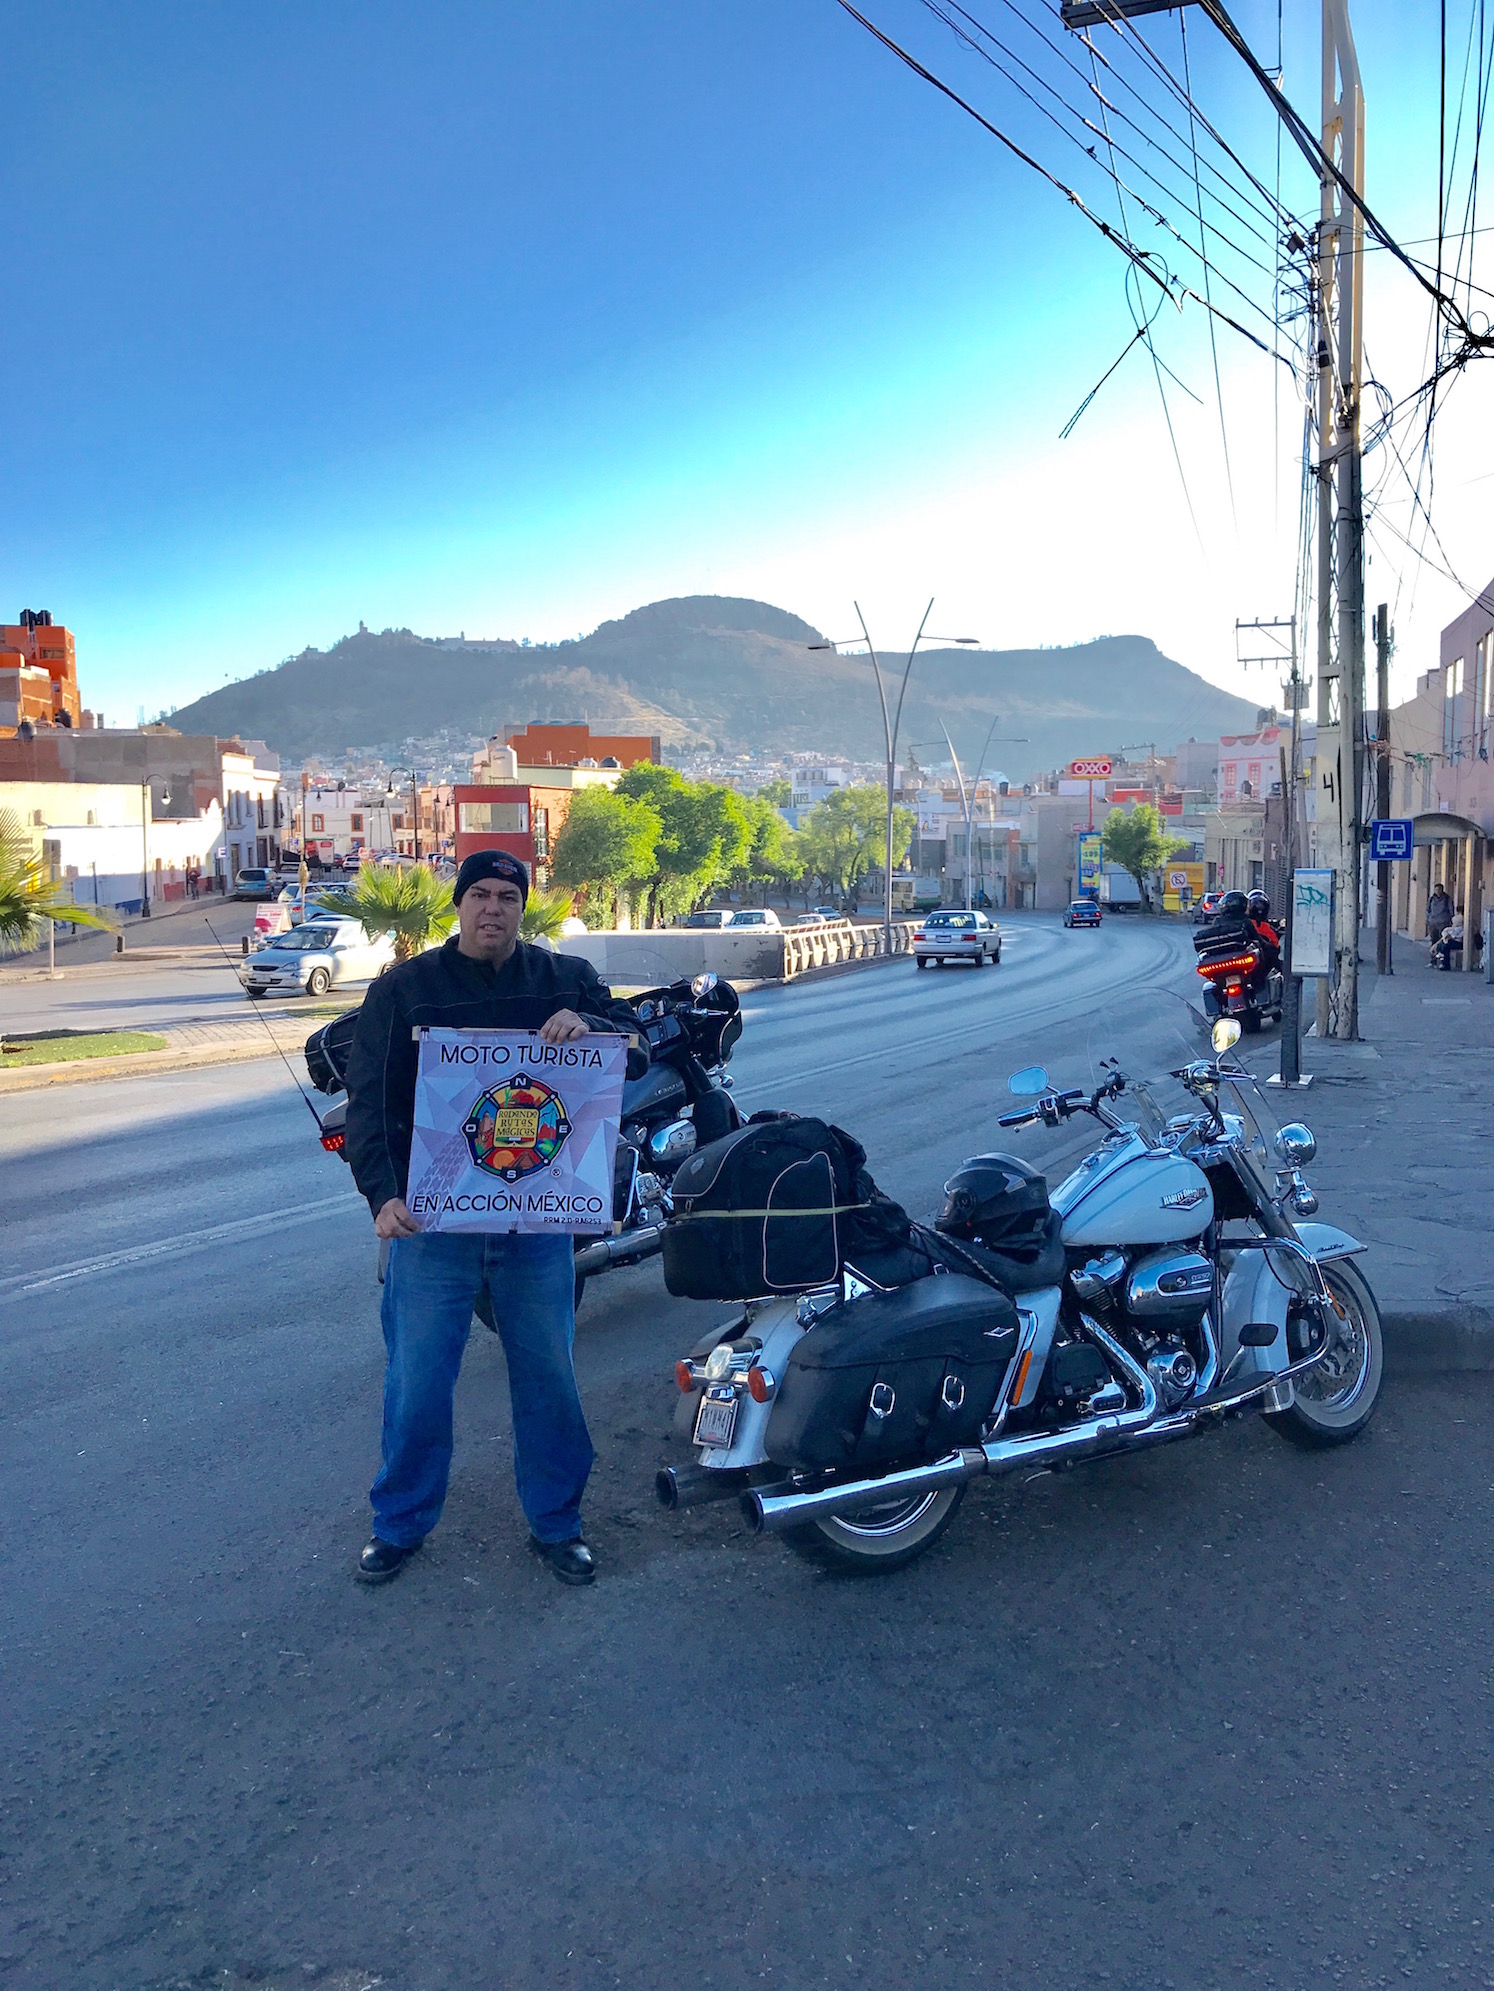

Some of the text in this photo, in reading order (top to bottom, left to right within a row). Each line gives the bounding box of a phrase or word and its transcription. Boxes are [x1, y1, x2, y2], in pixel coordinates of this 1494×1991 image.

[1074, 762, 1110, 774] OXXO
[1323, 771, 1334, 803] 4
[217, 847, 227, 858] E
[441, 1044, 603, 1068] MOTO TURISTA
[514, 1077, 528, 1086] N
[466, 1125, 476, 1133] O
[559, 1125, 568, 1133] E
[507, 1170, 517, 1178] S
[412, 1190, 603, 1213] EN ACCIÓN MÉXICO
[543, 1216, 560, 1224] RRM
